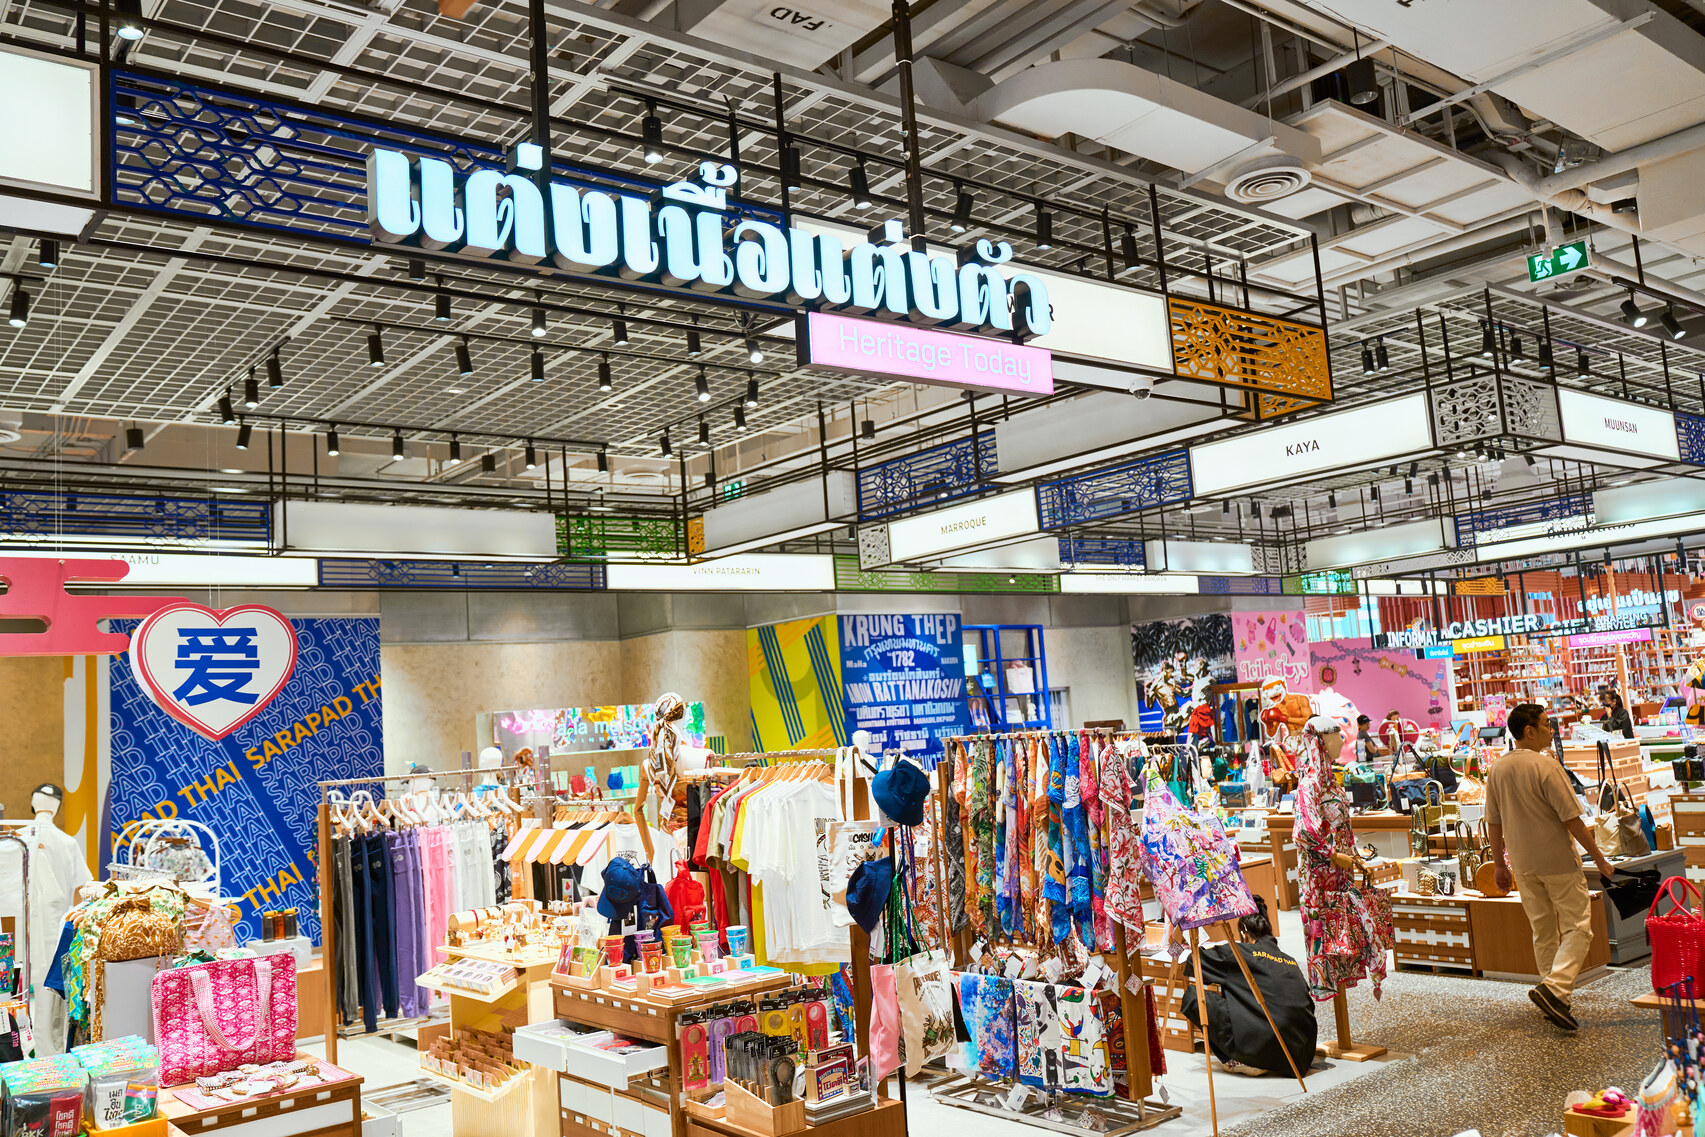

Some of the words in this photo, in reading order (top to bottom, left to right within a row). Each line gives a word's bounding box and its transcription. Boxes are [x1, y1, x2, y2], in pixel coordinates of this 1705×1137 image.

[770, 7, 825, 31] FAD
[839, 323, 952, 372] Heritage
[957, 342, 1031, 384] Today
[1285, 439, 1320, 457] KAYA
[940, 516, 987, 535] MARROQUE
[843, 614, 905, 647] KRUNG
[911, 614, 957, 645] THEP
[1449, 613, 1538, 639] CASHIER
[1595, 620, 1637, 632] SERVICE
[172, 627, 260, 706] 爱
[891, 650, 916, 668] 1782
[872, 678, 962, 703] RATTANAKOSIN
[245, 695, 353, 770] SARAPAD
[351, 674, 381, 704] TH
[166, 744, 231, 791] THAI
[255, 712, 363, 787] SARAPAD
[177, 761, 241, 807] THAI
[188, 778, 253, 826] THAI
[231, 846, 295, 893] THAI
[241, 862, 303, 910] THAI
[1252, 950, 1283, 964] SARAPAD
